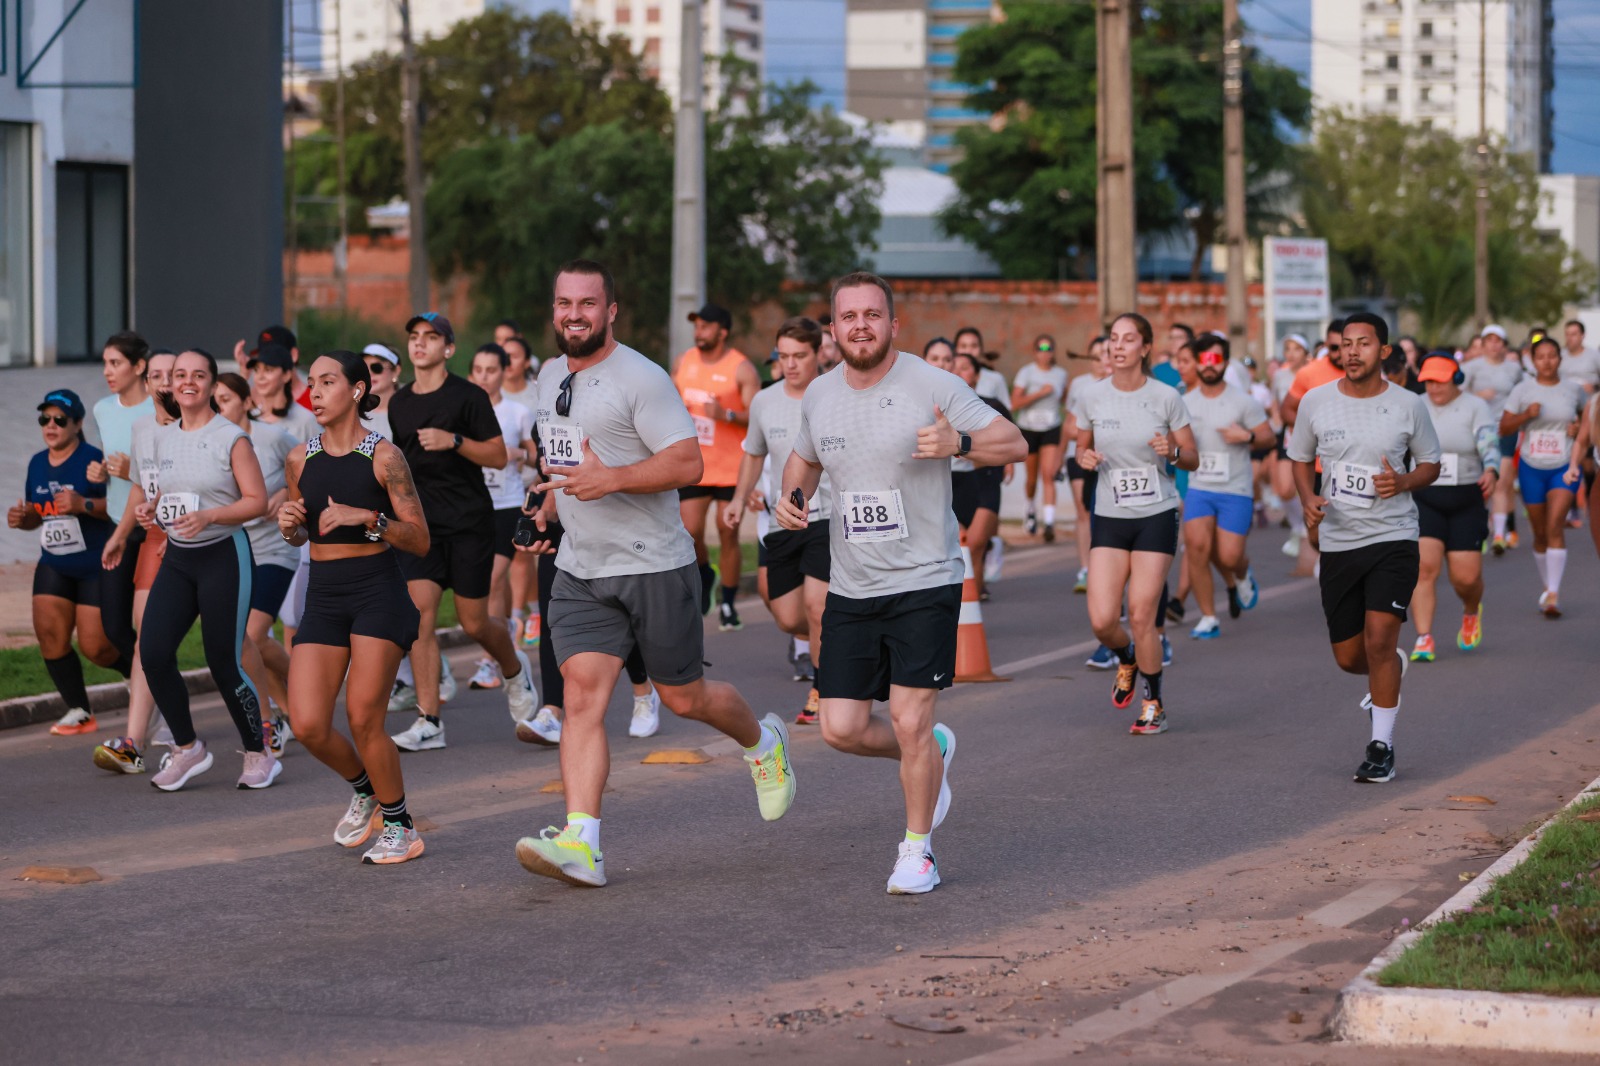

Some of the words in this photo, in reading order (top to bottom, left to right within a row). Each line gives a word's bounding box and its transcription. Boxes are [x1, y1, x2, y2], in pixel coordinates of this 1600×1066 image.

[549, 438, 573, 458] 146
[1119, 478, 1149, 492] 337
[1345, 474, 1367, 491] 50
[161, 504, 187, 520] 374
[851, 505, 889, 524] 188
[44, 528, 72, 544] 505
